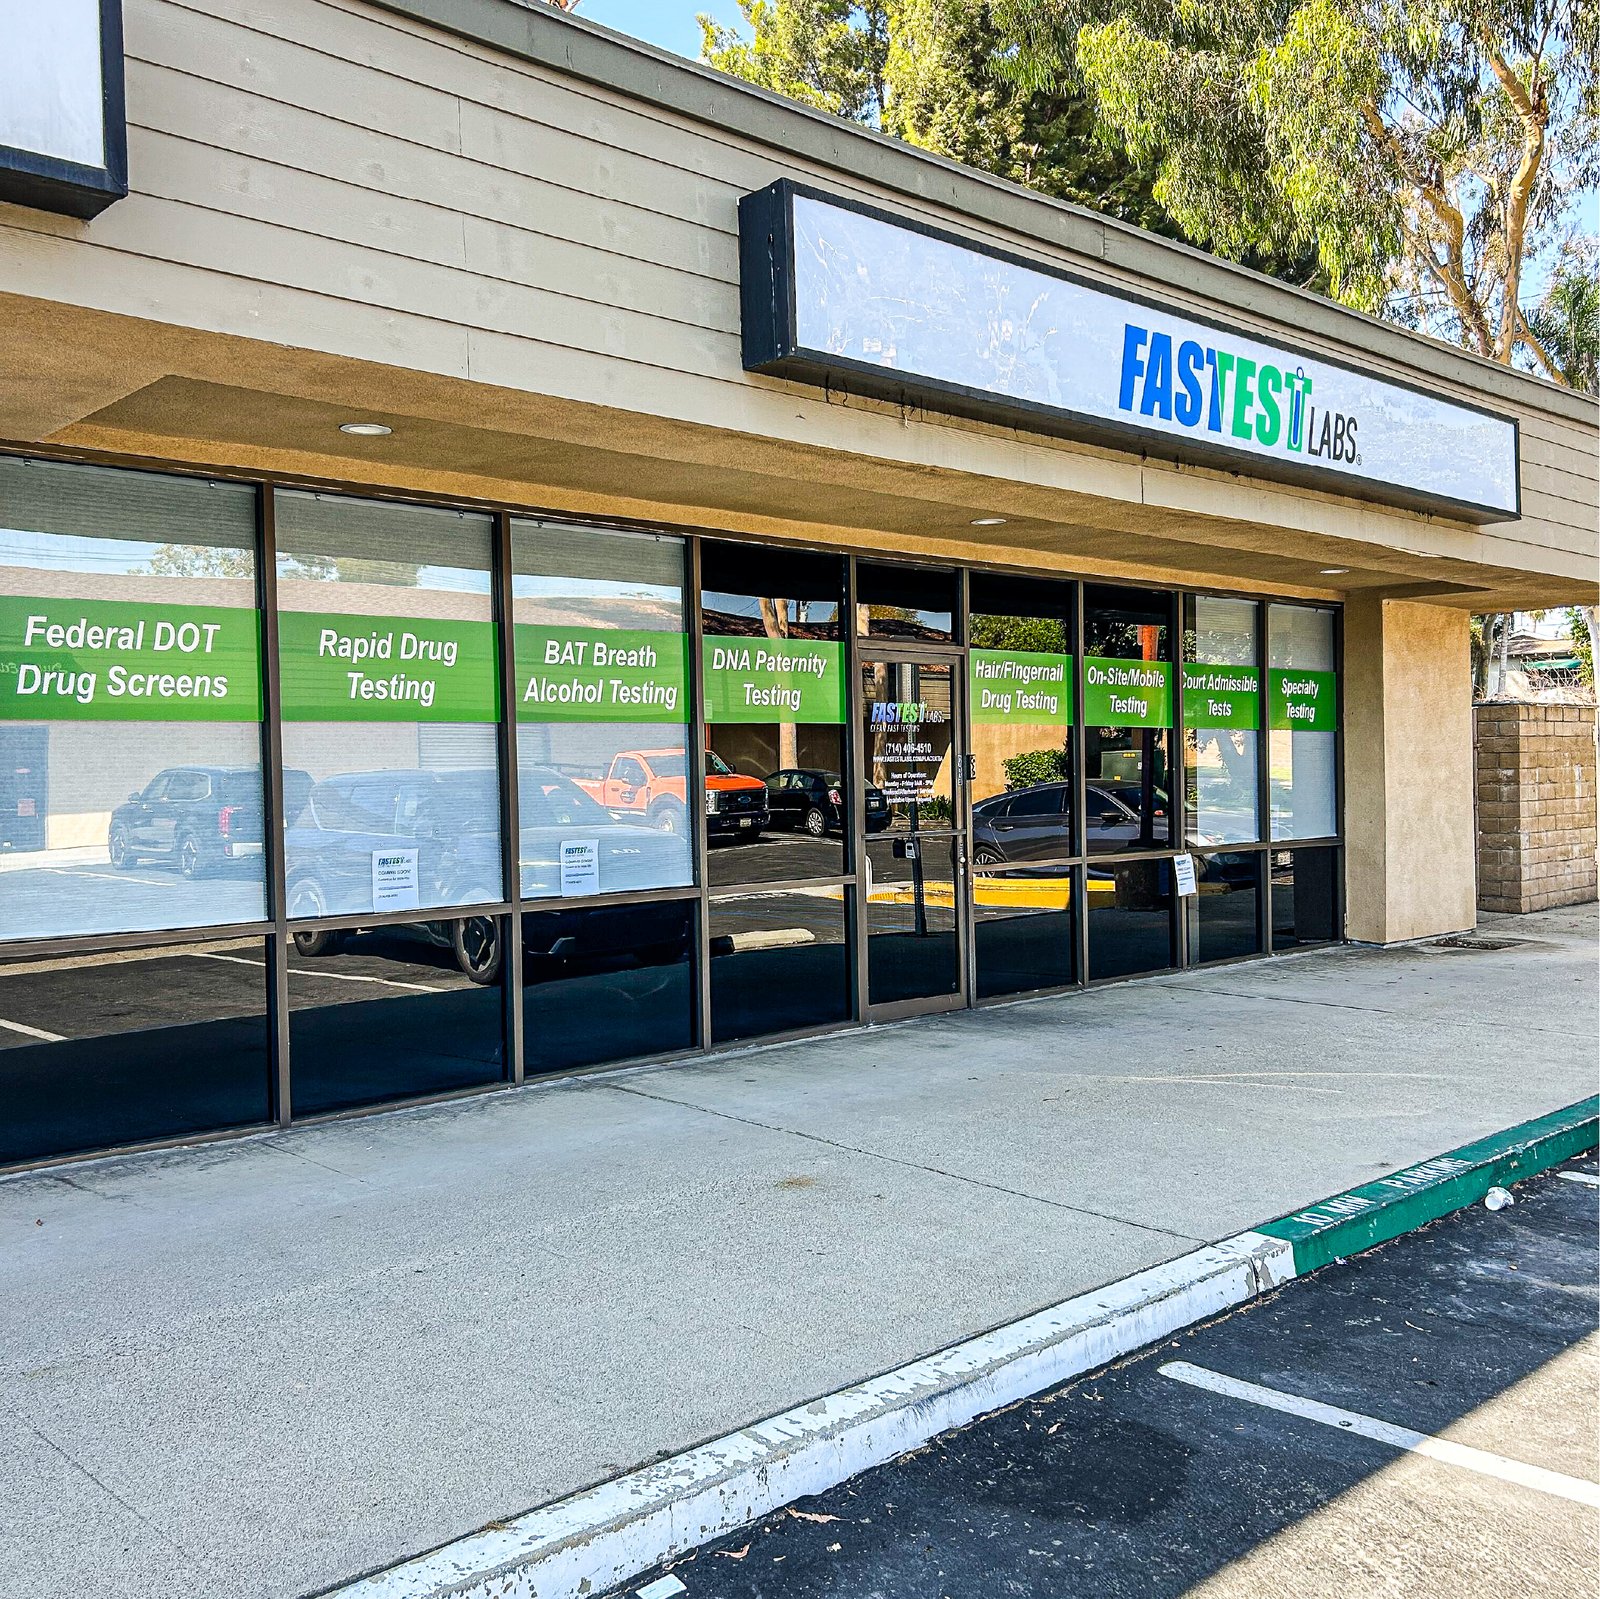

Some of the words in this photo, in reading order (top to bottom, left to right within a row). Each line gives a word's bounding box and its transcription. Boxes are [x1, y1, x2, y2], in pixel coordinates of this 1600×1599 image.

[1119, 324, 1312, 452] FASTEST
[24, 616, 145, 650] Federal
[153, 621, 221, 652] DOT
[319, 629, 393, 664] Rapid
[400, 633, 457, 667] Drug
[544, 640, 589, 665] BAT
[593, 642, 656, 667] Breath
[712, 648, 751, 671] DNA
[755, 650, 827, 678] Paternity
[16, 664, 96, 703] Drug
[107, 665, 228, 698] Screens
[347, 672, 436, 707] Testing
[1088, 666, 1165, 688] On-Site/Mobile
[1207, 674, 1257, 692] Admissible
[1281, 677, 1319, 699] Specialty
[523, 677, 604, 703] Alcohol
[609, 679, 678, 710] Testing
[743, 683, 801, 711] Testing
[981, 689, 1011, 713] Drug
[1016, 690, 1058, 714] Testing
[1109, 695, 1147, 718] Testing
[871, 701, 928, 723] FASTEST
[1207, 699, 1232, 716] Tests
[1286, 702, 1316, 723] Testing
[886, 743, 902, 755] (714)
[1291, 1213, 1334, 1226] 10
[1379, 1158, 1473, 1189] PARKING
